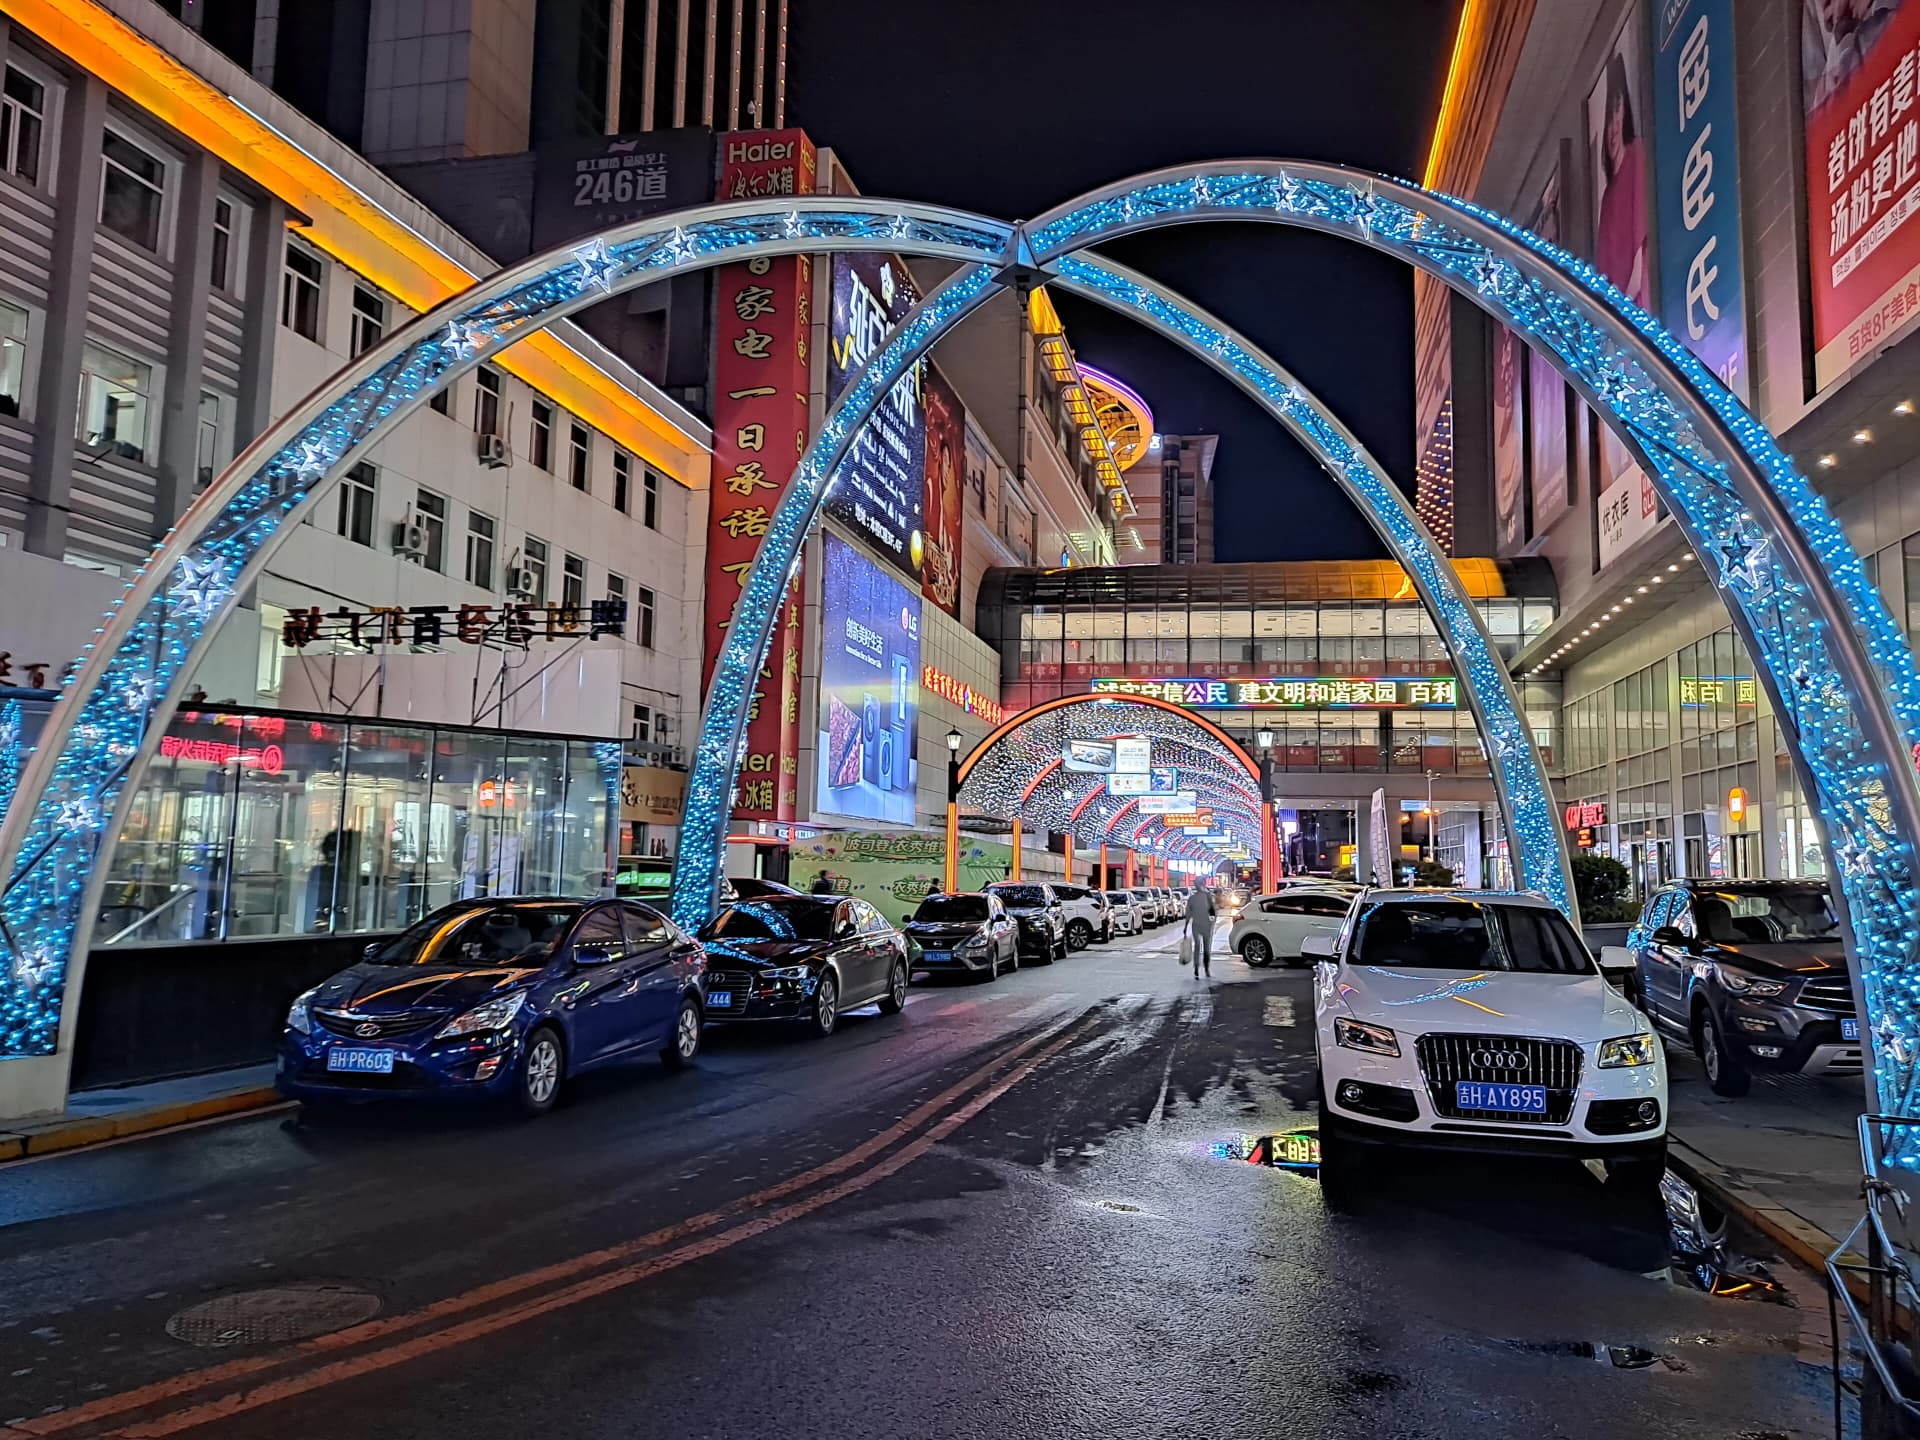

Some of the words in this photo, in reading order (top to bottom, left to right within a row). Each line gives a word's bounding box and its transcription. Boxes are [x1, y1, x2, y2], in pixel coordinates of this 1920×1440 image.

[1826, 46, 1920, 196] 卷饼有麦
[728, 138, 795, 164] Haier
[574, 166, 668, 206] 246道
[1848, 281, 1920, 359] 百货8F美食
[1602, 489, 1630, 537] 优衣库
[1238, 681, 1397, 704] 建文明和谐家园
[1408, 681, 1455, 704] 百利
[739, 752, 775, 773] ier
[844, 838, 890, 852] 波司登
